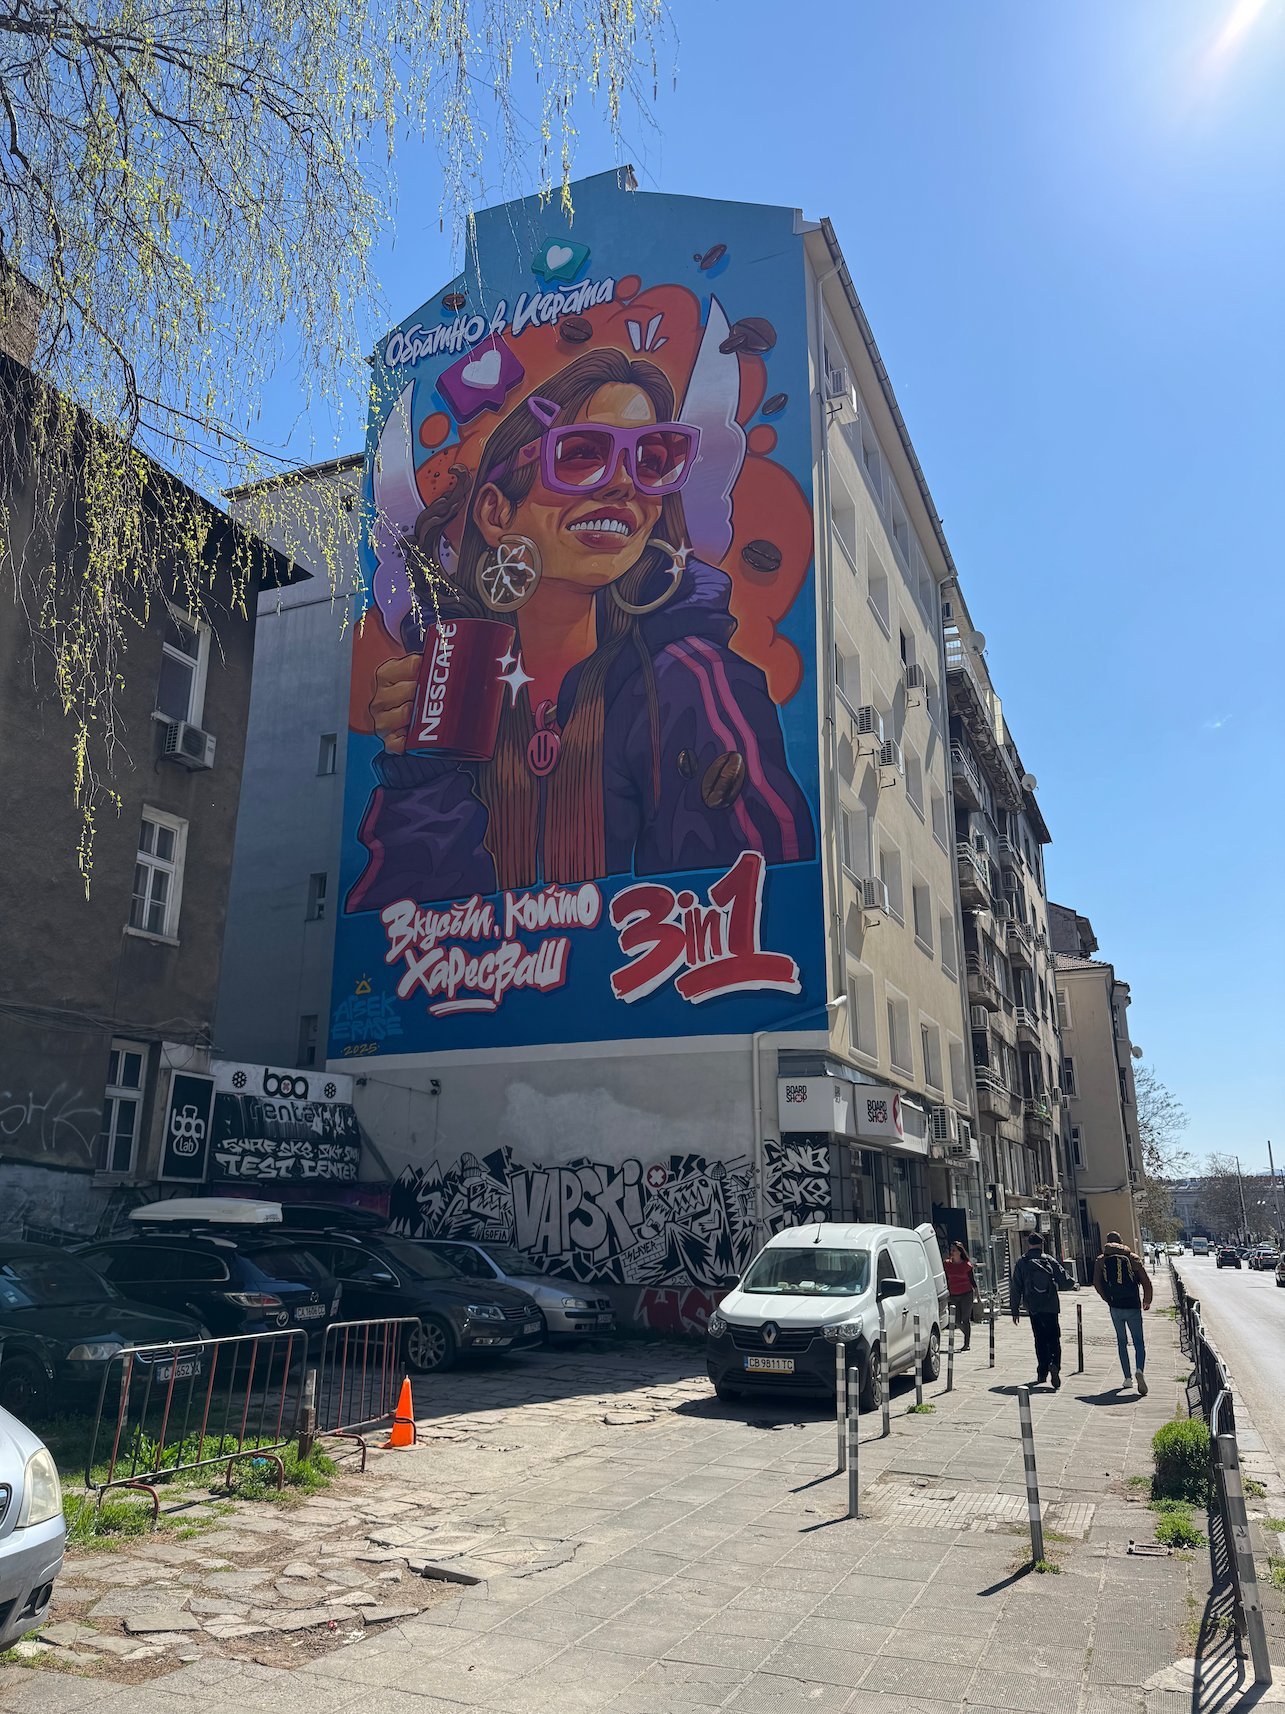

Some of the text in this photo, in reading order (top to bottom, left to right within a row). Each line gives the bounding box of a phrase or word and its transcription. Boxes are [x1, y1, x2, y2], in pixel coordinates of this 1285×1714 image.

[786, 1085, 807, 1094] BOARD
[786, 1093, 807, 1103] SHOP
[867, 1100, 887, 1111] BOARD
[179, 1138, 194, 1152] lab
[215, 1153, 358, 1180] TEST CENTER
